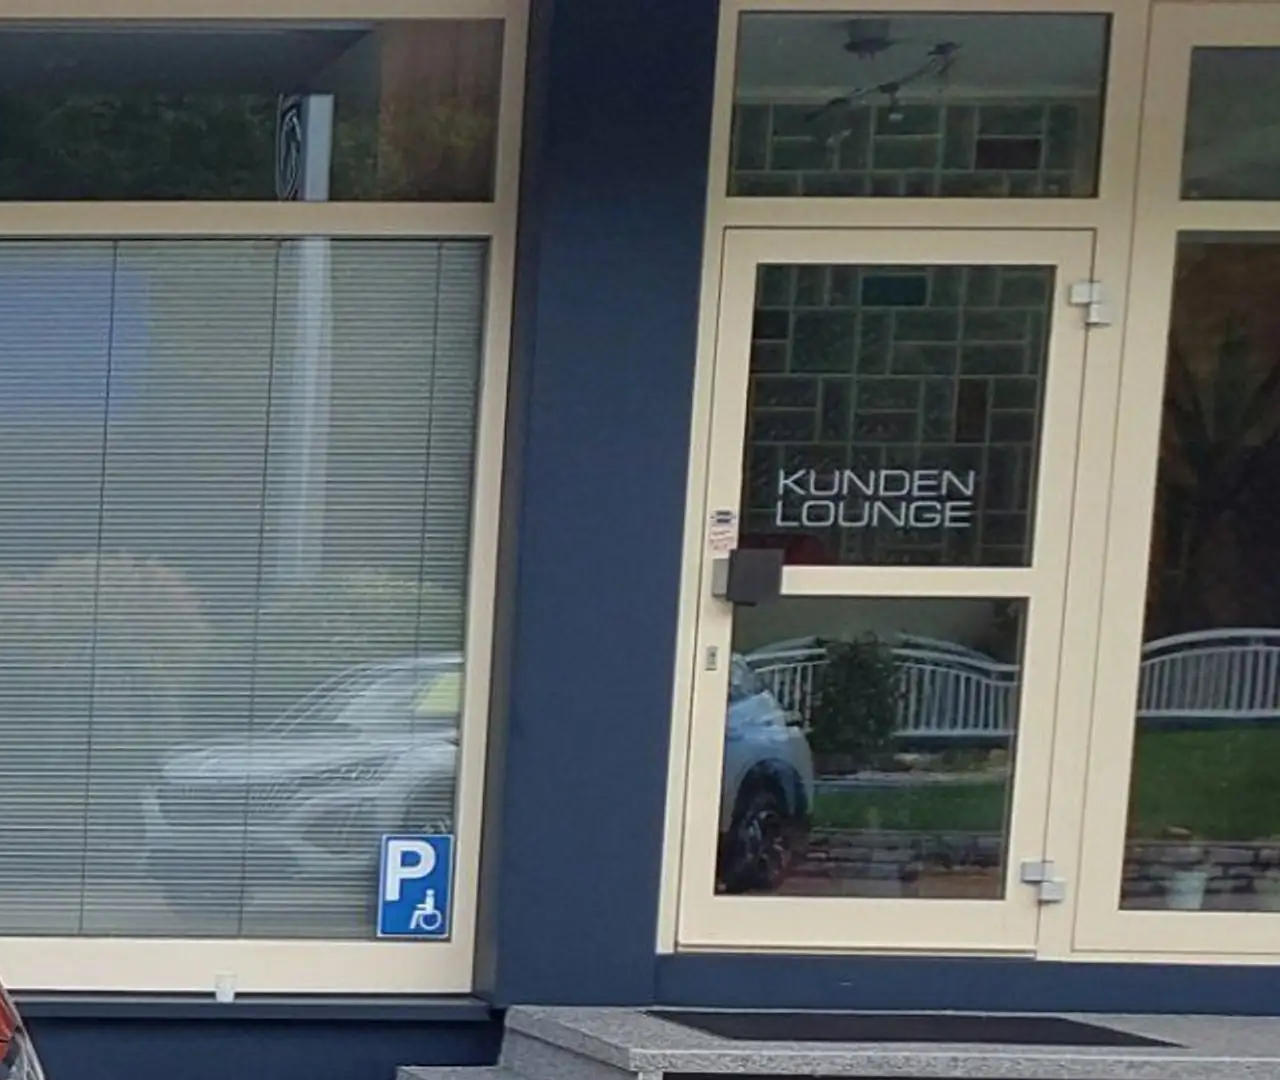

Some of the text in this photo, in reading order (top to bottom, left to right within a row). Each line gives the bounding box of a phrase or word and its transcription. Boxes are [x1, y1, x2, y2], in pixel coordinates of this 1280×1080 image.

[778, 469, 976, 497] KUNDEN
[775, 500, 973, 528] LOUNGE
[385, 839, 437, 901] P
